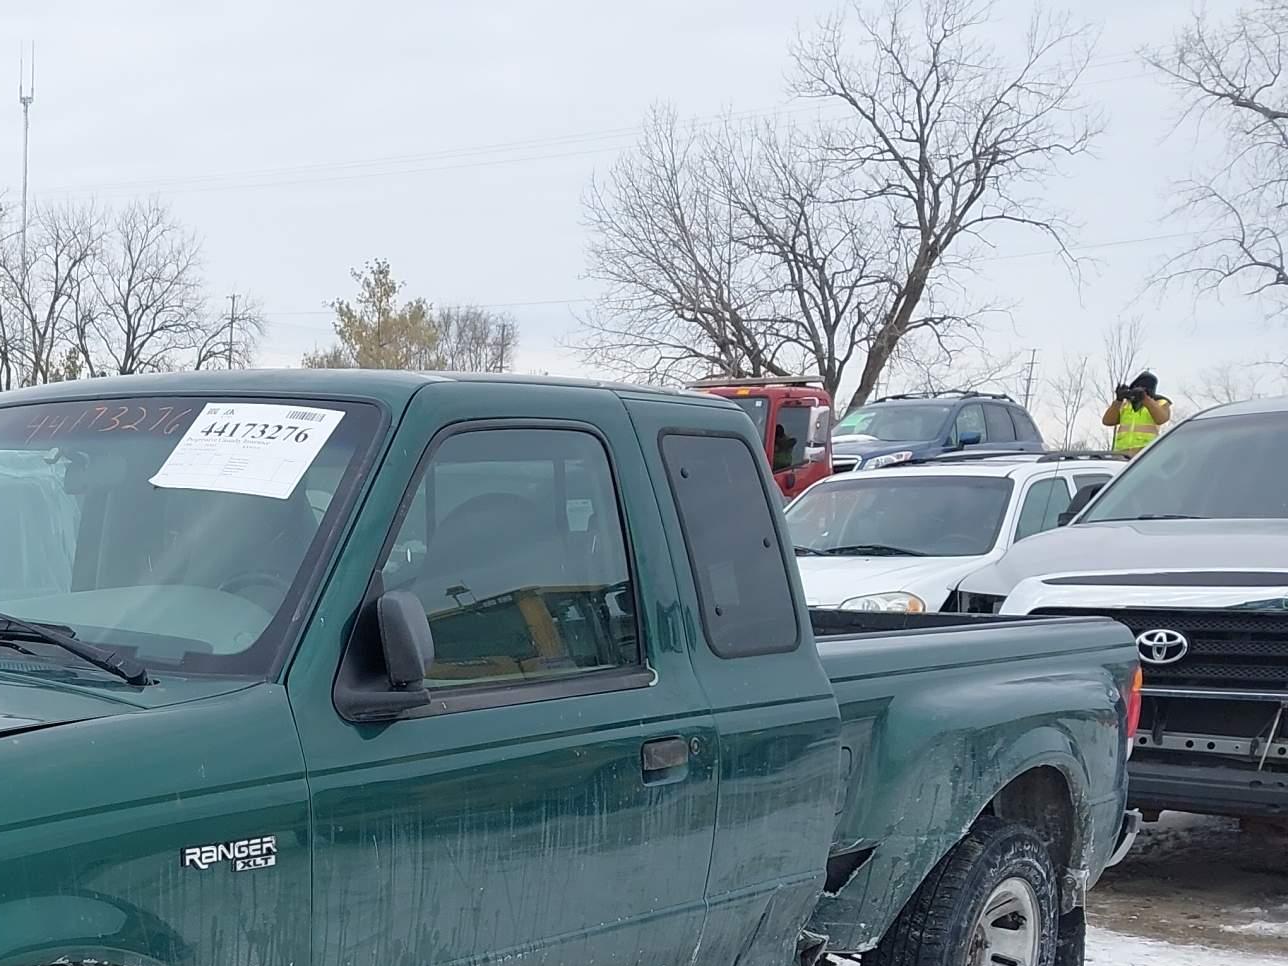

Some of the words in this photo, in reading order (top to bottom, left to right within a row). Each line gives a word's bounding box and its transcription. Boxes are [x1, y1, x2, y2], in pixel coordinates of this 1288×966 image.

[24, 406, 192, 445] 44173276
[200, 421, 313, 443] 44173276
[184, 835, 277, 870] RANGER
[238, 855, 274, 870] XLT
